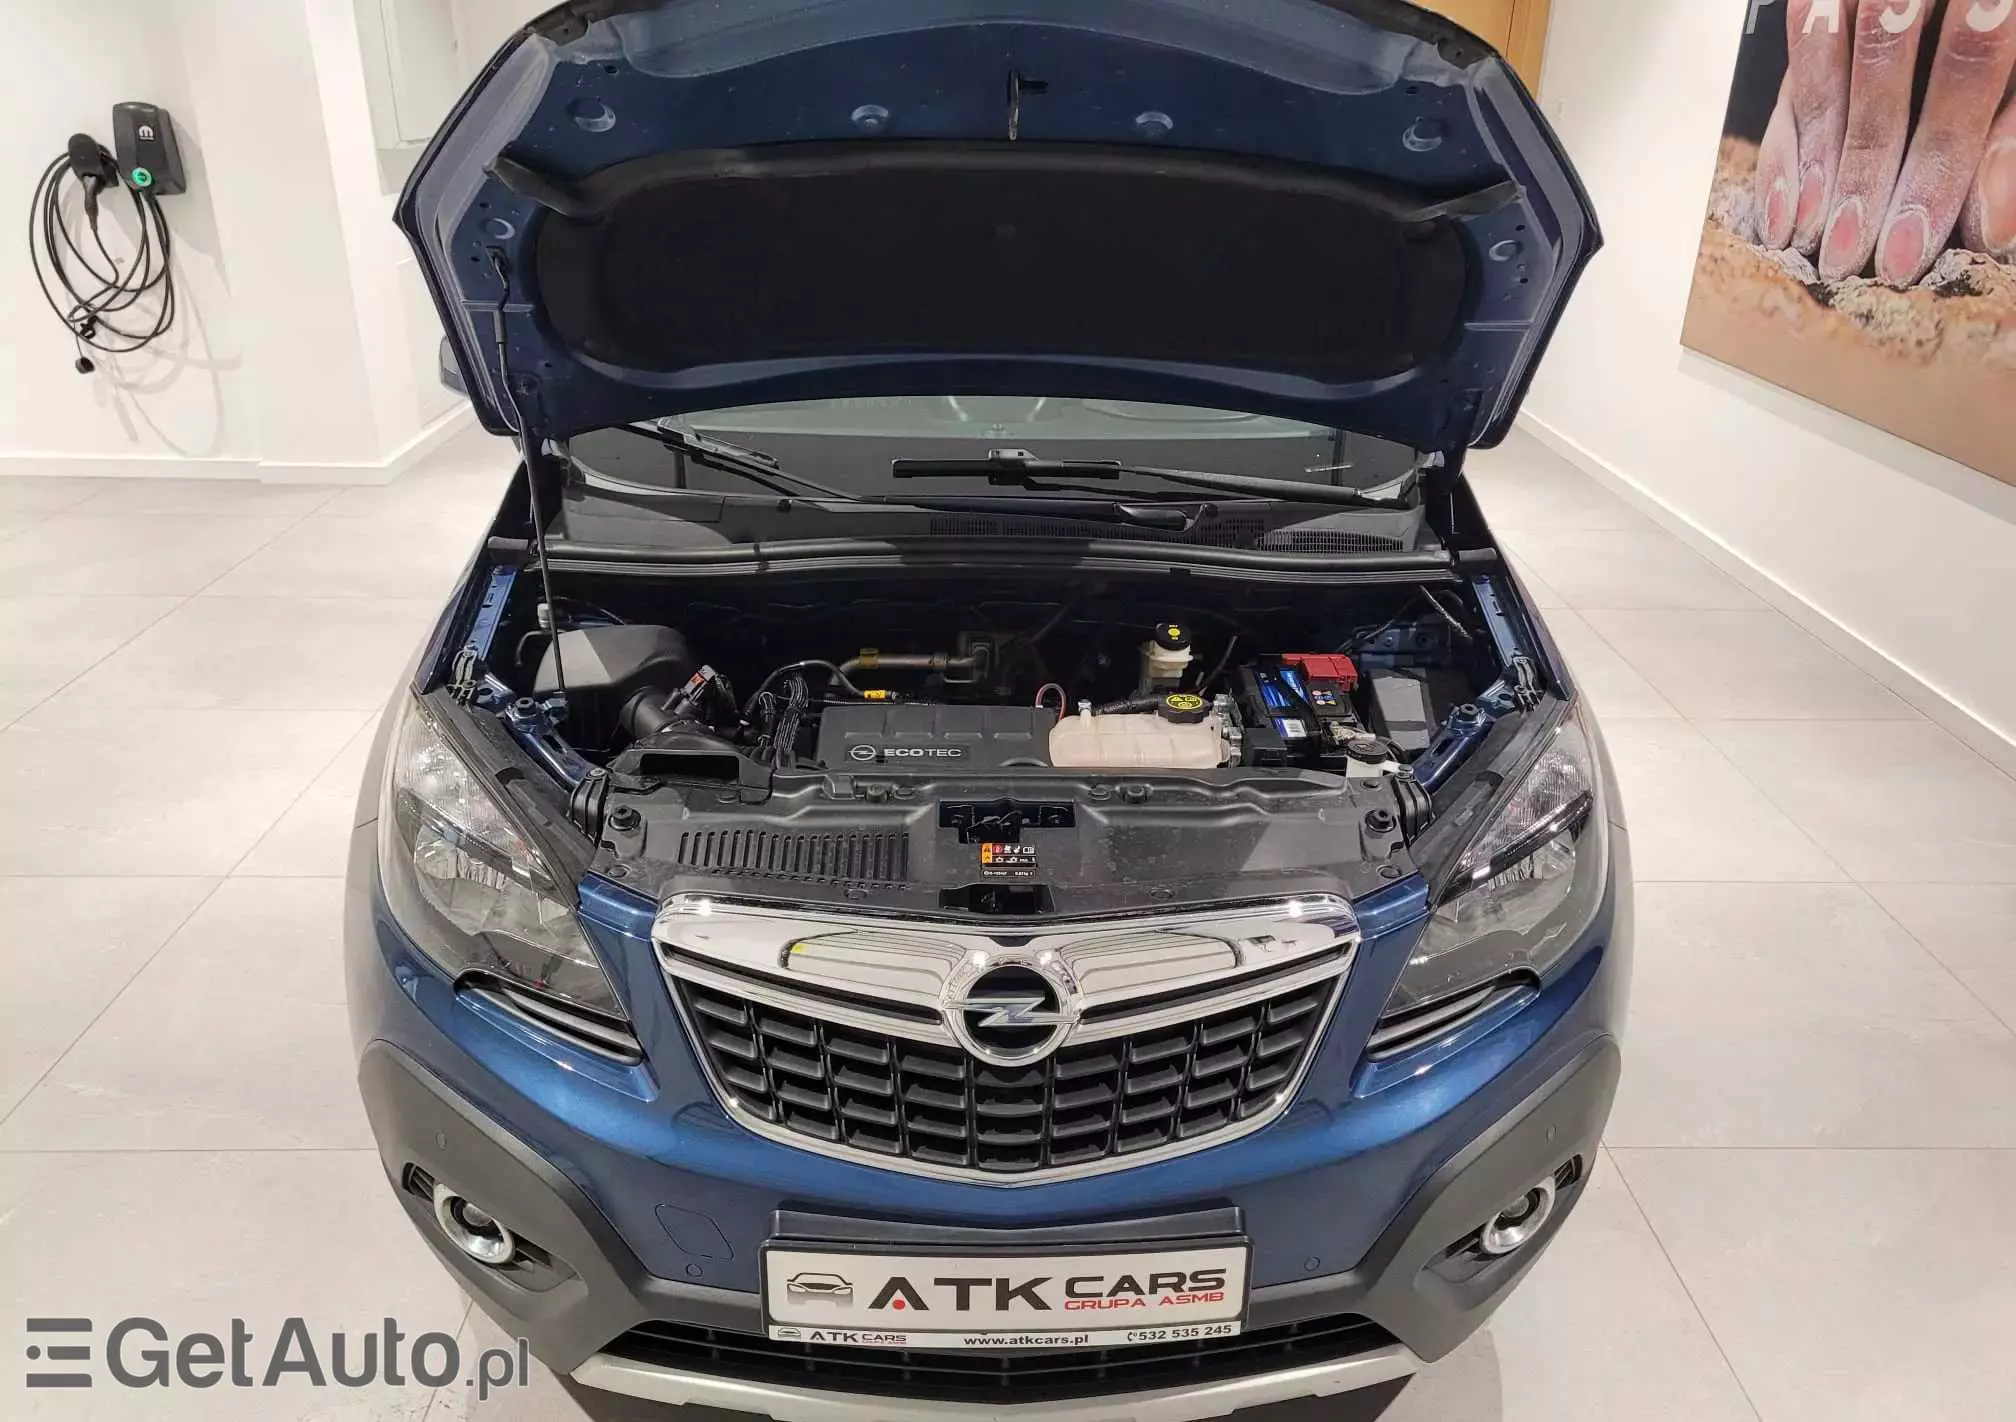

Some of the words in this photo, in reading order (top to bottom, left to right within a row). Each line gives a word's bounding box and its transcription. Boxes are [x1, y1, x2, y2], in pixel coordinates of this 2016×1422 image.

[883, 748, 962, 757] ECOTEC
[867, 1276, 1054, 1311] ATK
[1065, 1268, 1227, 1298] CARS
[1064, 1298, 1146, 1311] GRUPA
[1158, 1291, 1225, 1306] ASMB
[810, 1331, 859, 1343] ATK
[862, 1333, 907, 1342] CARS
[963, 1333, 1089, 1346] www.atkcars.pl
[1138, 1330, 1167, 1341] 532
[1171, 1327, 1200, 1339] 535
[1204, 1325, 1233, 1336] 245
